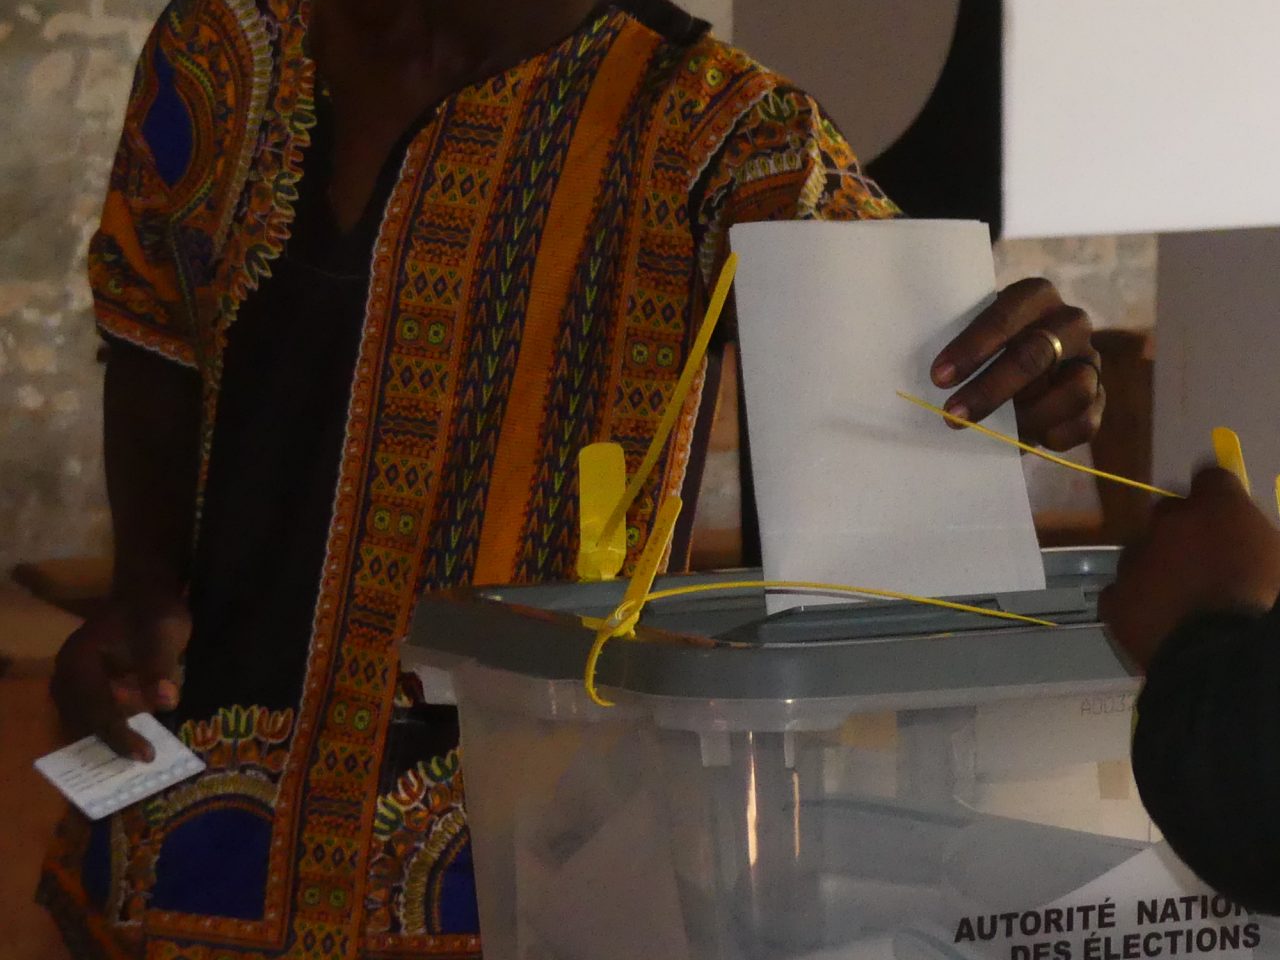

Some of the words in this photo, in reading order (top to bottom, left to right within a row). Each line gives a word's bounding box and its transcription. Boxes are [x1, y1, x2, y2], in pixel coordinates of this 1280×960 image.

[954, 897, 1117, 943] AUTORITÉ
[1011, 940, 1073, 960] DES
[1083, 923, 1261, 960] ÉLECTIONS
